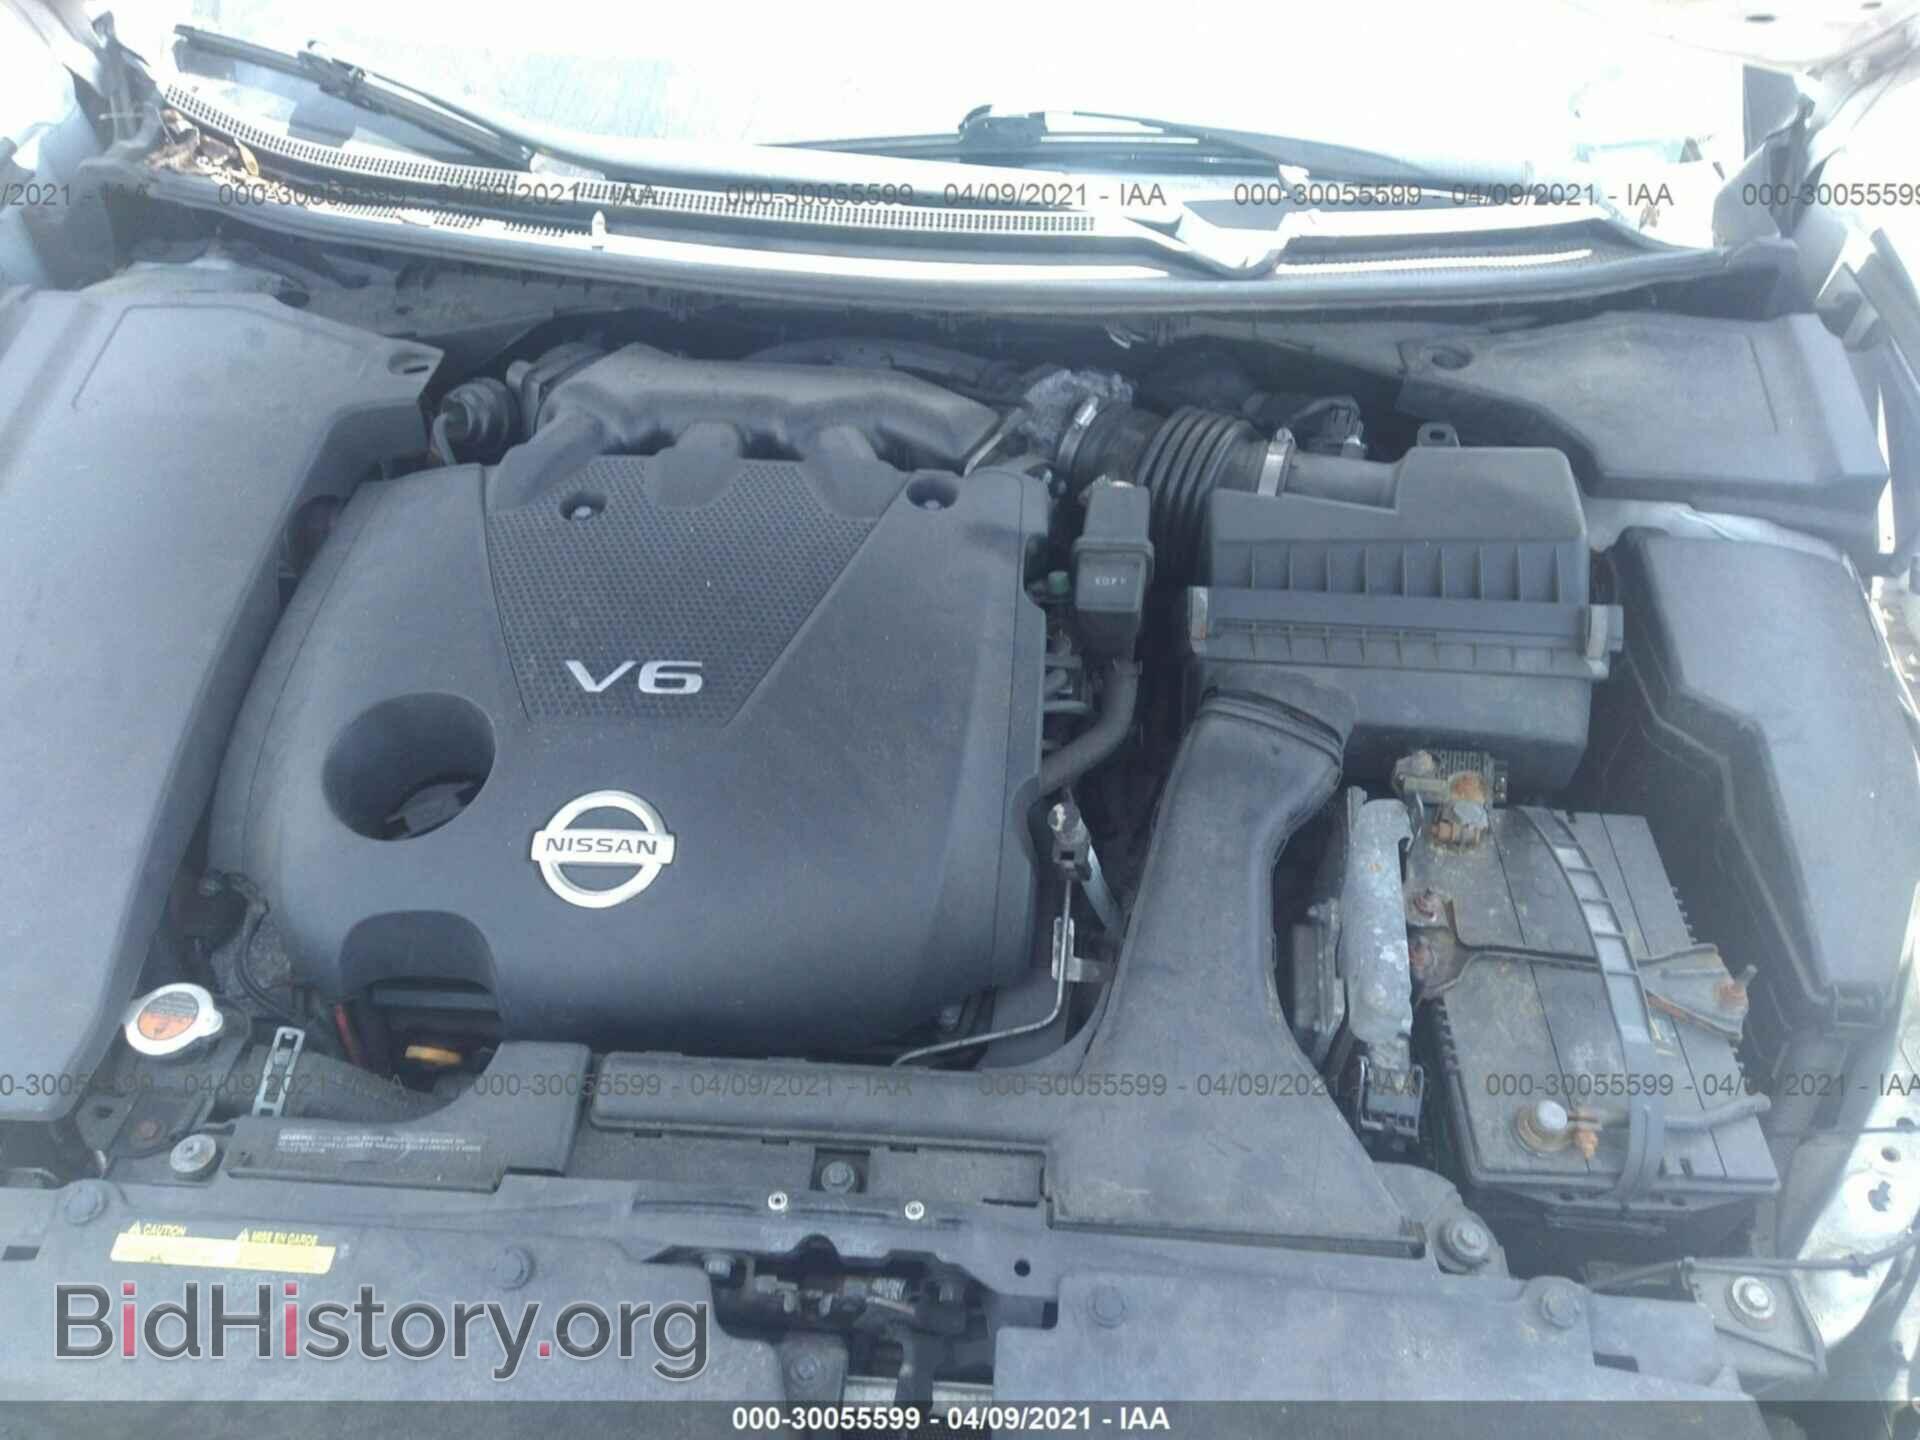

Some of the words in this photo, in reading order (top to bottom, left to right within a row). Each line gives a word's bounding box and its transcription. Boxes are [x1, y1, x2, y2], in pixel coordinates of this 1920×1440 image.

[565, 660, 703, 694] V6
[545, 837, 657, 855] NISSAN
[143, 1224, 187, 1237] CAUTION
